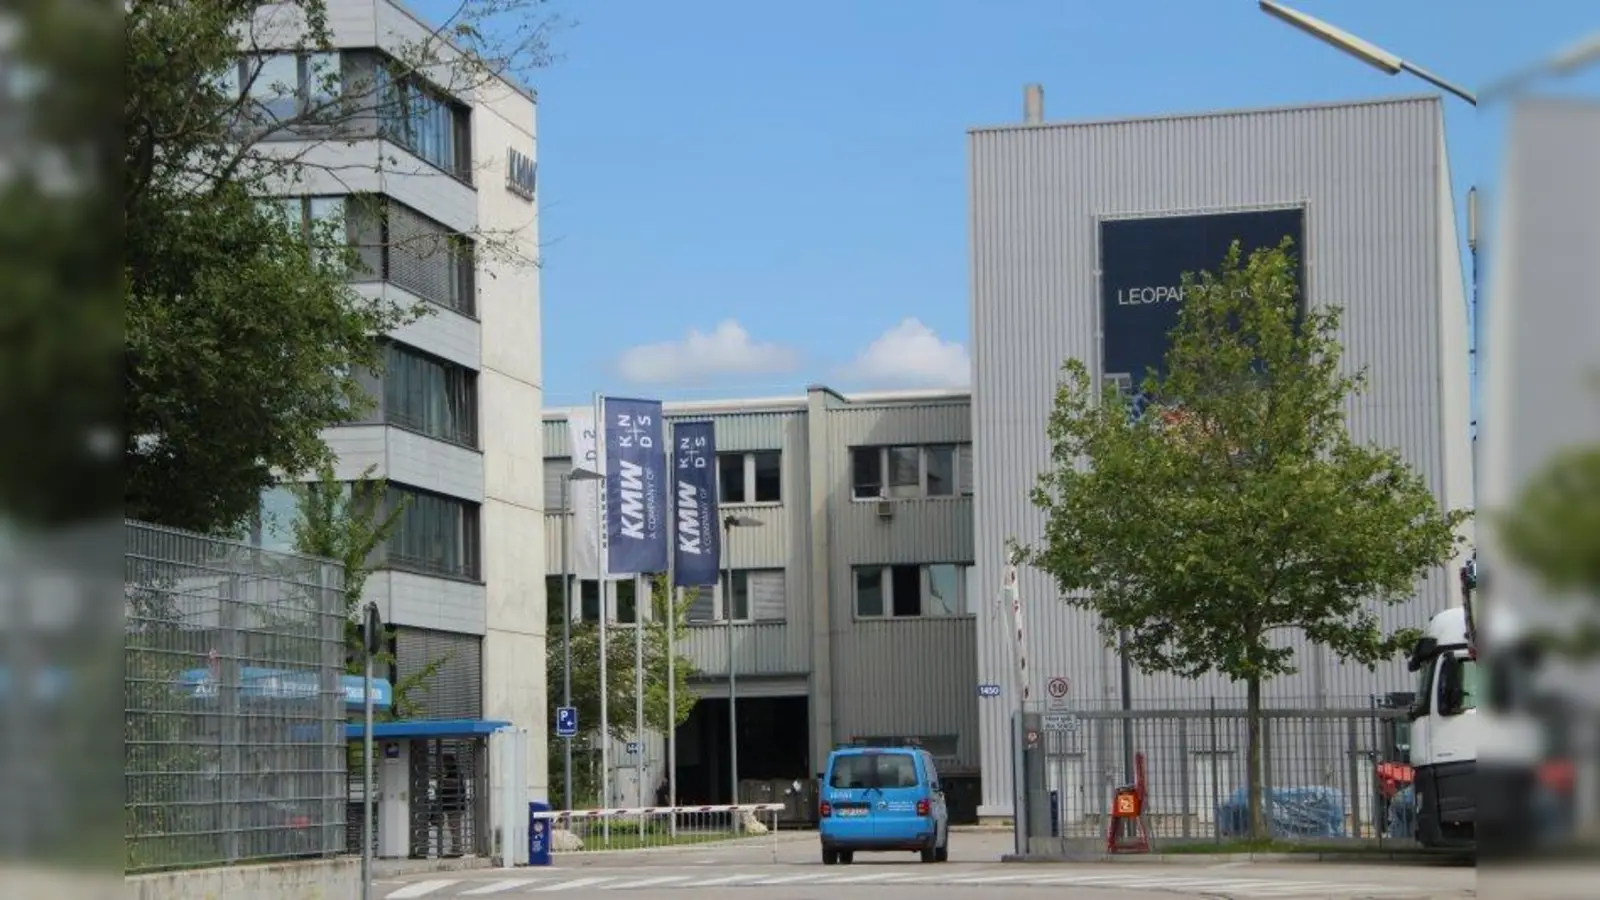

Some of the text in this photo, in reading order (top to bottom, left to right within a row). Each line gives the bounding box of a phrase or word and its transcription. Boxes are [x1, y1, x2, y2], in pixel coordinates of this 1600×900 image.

[620, 460, 644, 539] KMW
[679, 481, 700, 554] KMW
[1052, 683, 1064, 693] 10
[560, 710, 568, 721] P
